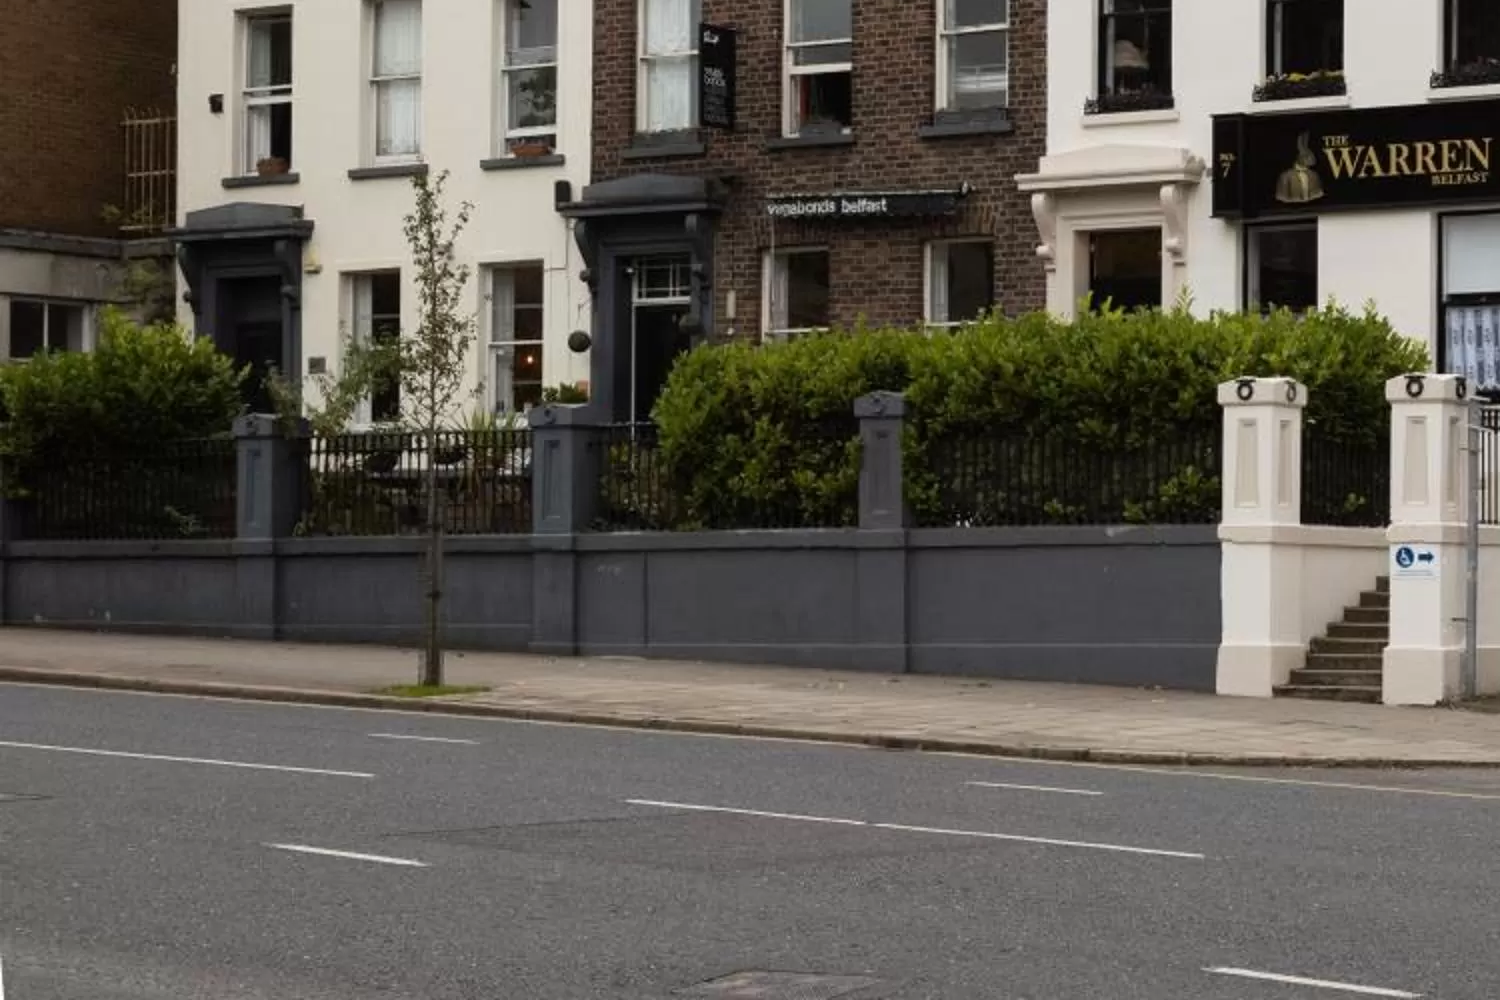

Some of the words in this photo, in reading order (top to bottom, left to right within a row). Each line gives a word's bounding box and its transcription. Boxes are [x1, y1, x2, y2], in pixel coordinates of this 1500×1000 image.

[1322, 135, 1349, 147] THE
[1322, 137, 1495, 180] WARREN
[1221, 161, 1231, 178] 7
[1431, 171, 1489, 185] BELFAST
[767, 200, 836, 217] vagabonds
[841, 198, 887, 213] belfast
